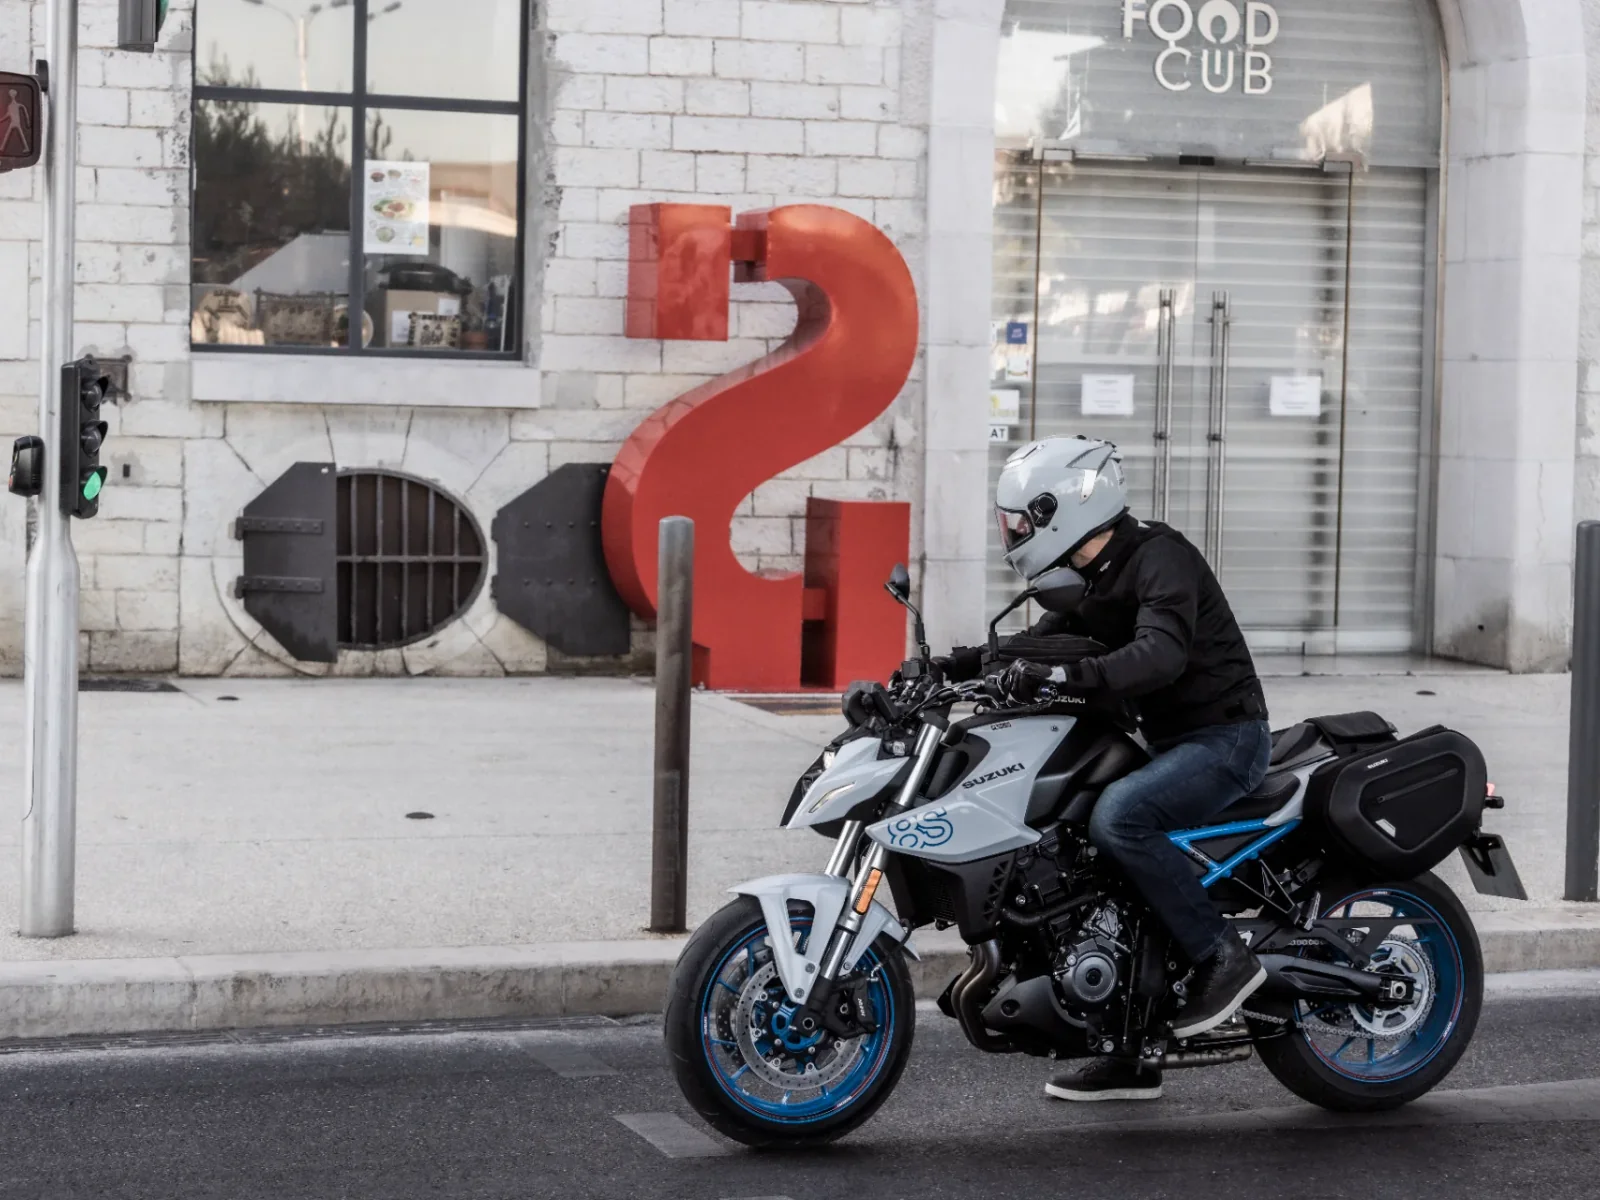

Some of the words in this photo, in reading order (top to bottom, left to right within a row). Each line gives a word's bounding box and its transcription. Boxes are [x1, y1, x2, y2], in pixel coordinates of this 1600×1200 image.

[1122, 0, 1279, 45] FOOD
[1155, 46, 1272, 94] CUB
[1053, 694, 1086, 704] UZUKI
[962, 762, 1026, 790] SUZUKI
